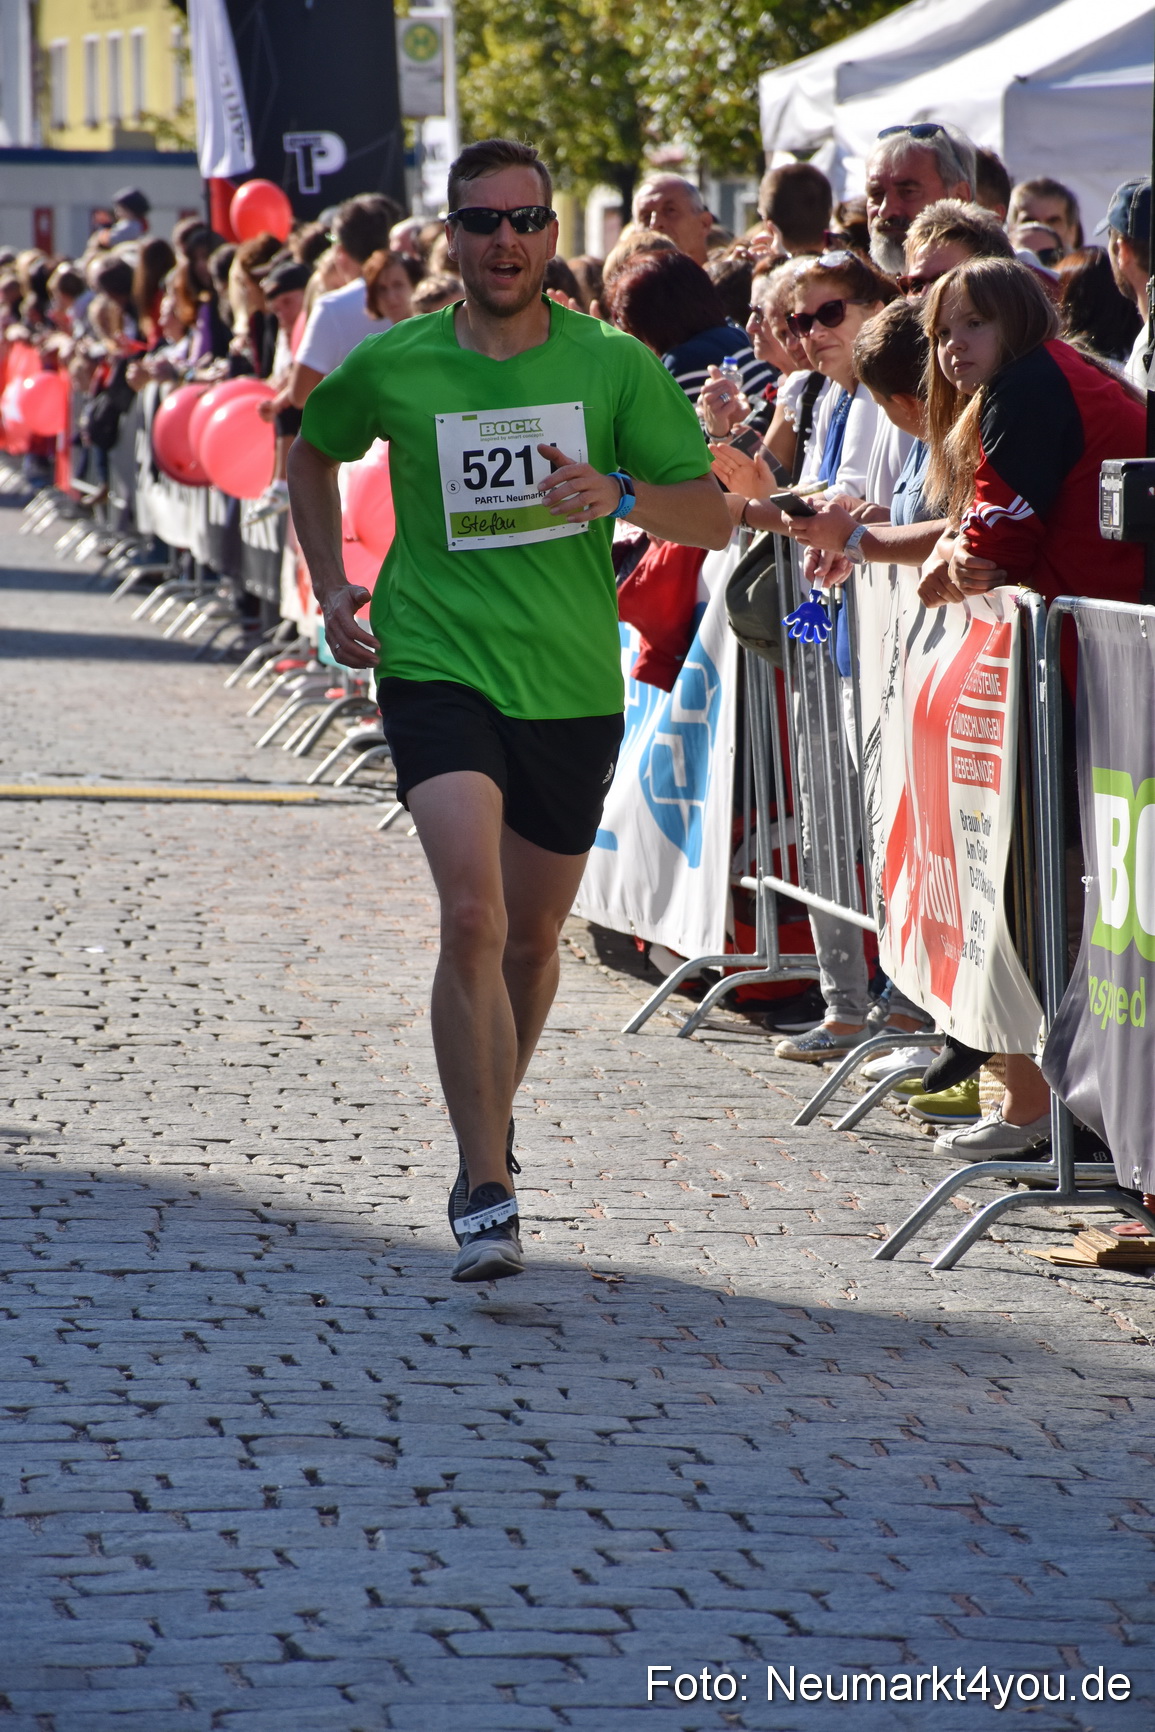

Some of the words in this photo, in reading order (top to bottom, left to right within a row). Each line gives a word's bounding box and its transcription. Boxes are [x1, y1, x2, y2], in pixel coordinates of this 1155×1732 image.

[479, 418, 543, 437] BOCK
[475, 496, 504, 505] PARTL
[507, 490, 546, 502] Neumarkt
